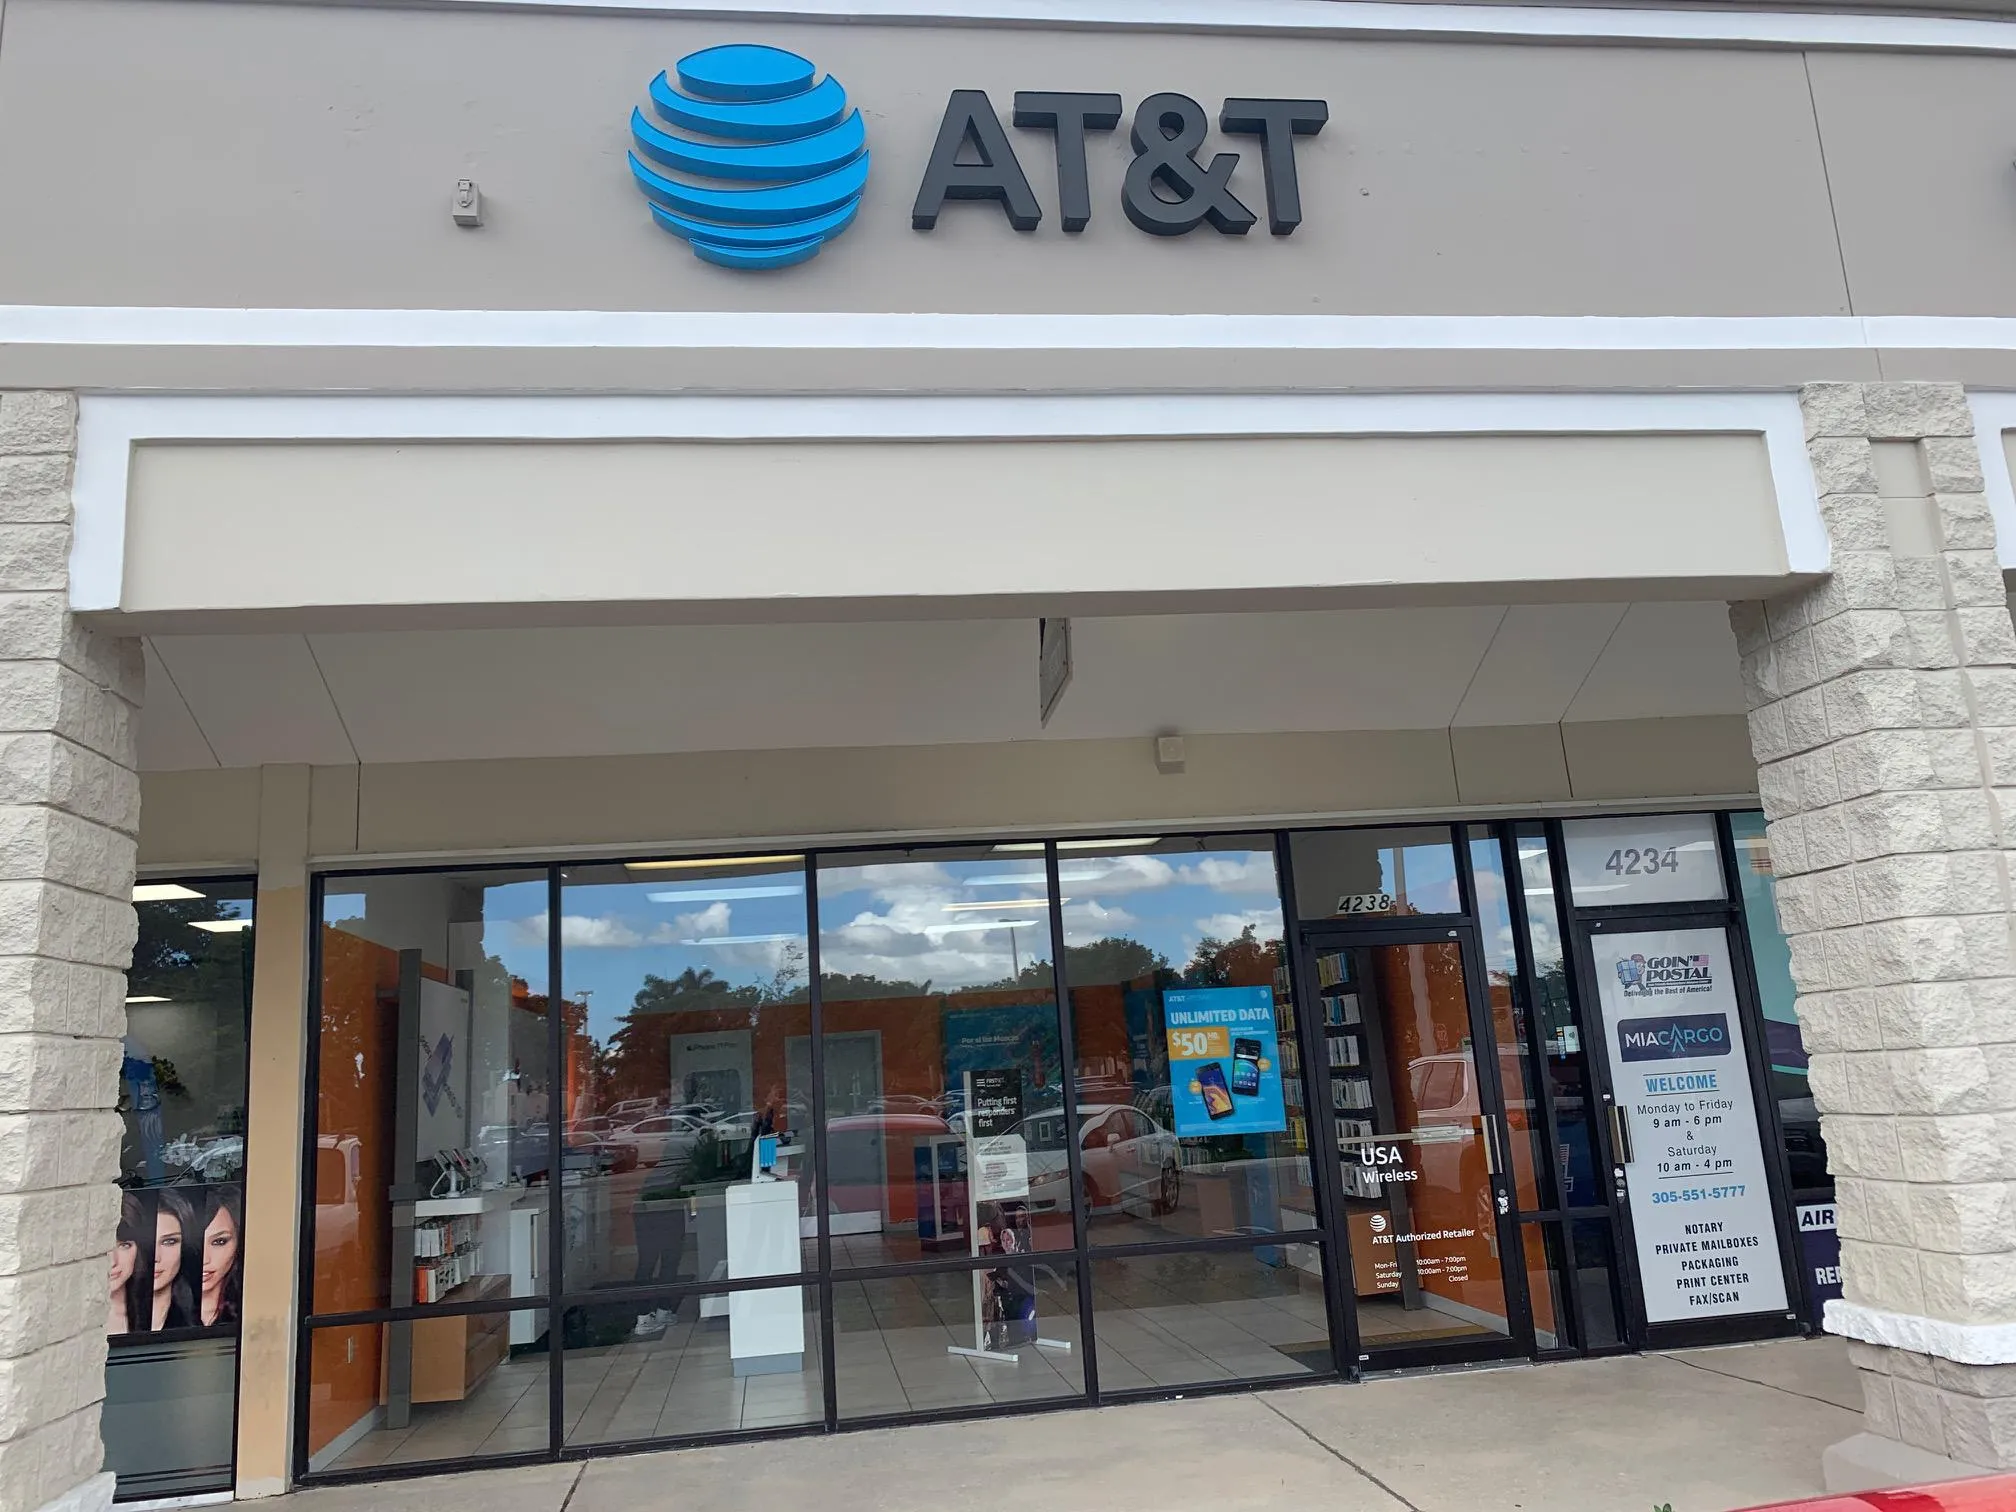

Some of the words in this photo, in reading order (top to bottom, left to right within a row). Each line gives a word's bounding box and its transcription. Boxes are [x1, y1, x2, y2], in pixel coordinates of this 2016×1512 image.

[911, 88, 1330, 236] AT&T
[1605, 846, 1679, 876] 4234
[1338, 894, 1390, 913] 4238
[1646, 966, 1713, 981] POSTAL
[1654, 988, 1664, 996] the
[1665, 986, 1678, 995] Best
[1679, 986, 1686, 994] of
[1686, 985, 1713, 993] America!
[1170, 1009, 1237, 1025] UNLIMITED
[1238, 1007, 1271, 1021] DATA
[1172, 1031, 1208, 1057] $50
[1645, 1074, 1718, 1093] WELCOME
[977, 1097, 1002, 1108] Putting
[1003, 1096, 1017, 1105] first
[1637, 1103, 1680, 1115] Monday
[1684, 1102, 1695, 1112] to
[1699, 1099, 1733, 1110] Friday
[978, 1107, 1015, 1118] responders
[978, 1118, 993, 1128] first
[1653, 1118, 1660, 1129] 9
[1664, 1119, 1681, 1128] am
[1693, 1115, 1700, 1125] 6
[1704, 1115, 1722, 1127] pm
[1686, 1130, 1695, 1141] &
[1360, 1146, 1404, 1166] USA
[1667, 1145, 1717, 1157] Saturday
[1657, 1162, 1670, 1173] 10
[1674, 1162, 1691, 1171] am
[1704, 1159, 1711, 1169] 4
[1715, 1159, 1732, 1170] pm
[1362, 1169, 1418, 1184] Wireless
[1651, 1185, 1746, 1204] 305-551-5777
[1801, 1209, 1835, 1227] AIR
[1684, 1221, 1724, 1235] NOTARY
[1372, 1234, 1394, 1245] AT&T
[1395, 1230, 1442, 1243] Authorized
[1443, 1228, 1475, 1239] Retailer
[1655, 1241, 1698, 1255] PRIVATE
[1701, 1236, 1759, 1251] MAILBOXES
[1374, 1262, 1398, 1270] Mon-Fri
[1444, 1255, 1466, 1265] 7:00pm
[1681, 1256, 1739, 1271] PACKAGING
[1375, 1271, 1402, 1280] Saturday
[1417, 1267, 1442, 1275] 10:00am
[1446, 1265, 1467, 1274] 7:00pm
[1376, 1281, 1399, 1289] Sunday
[1448, 1274, 1469, 1283] Closed
[1676, 1276, 1707, 1289] PRINT
[1710, 1272, 1750, 1286] CENTER
[1689, 1291, 1740, 1306] FAX/SCAN
